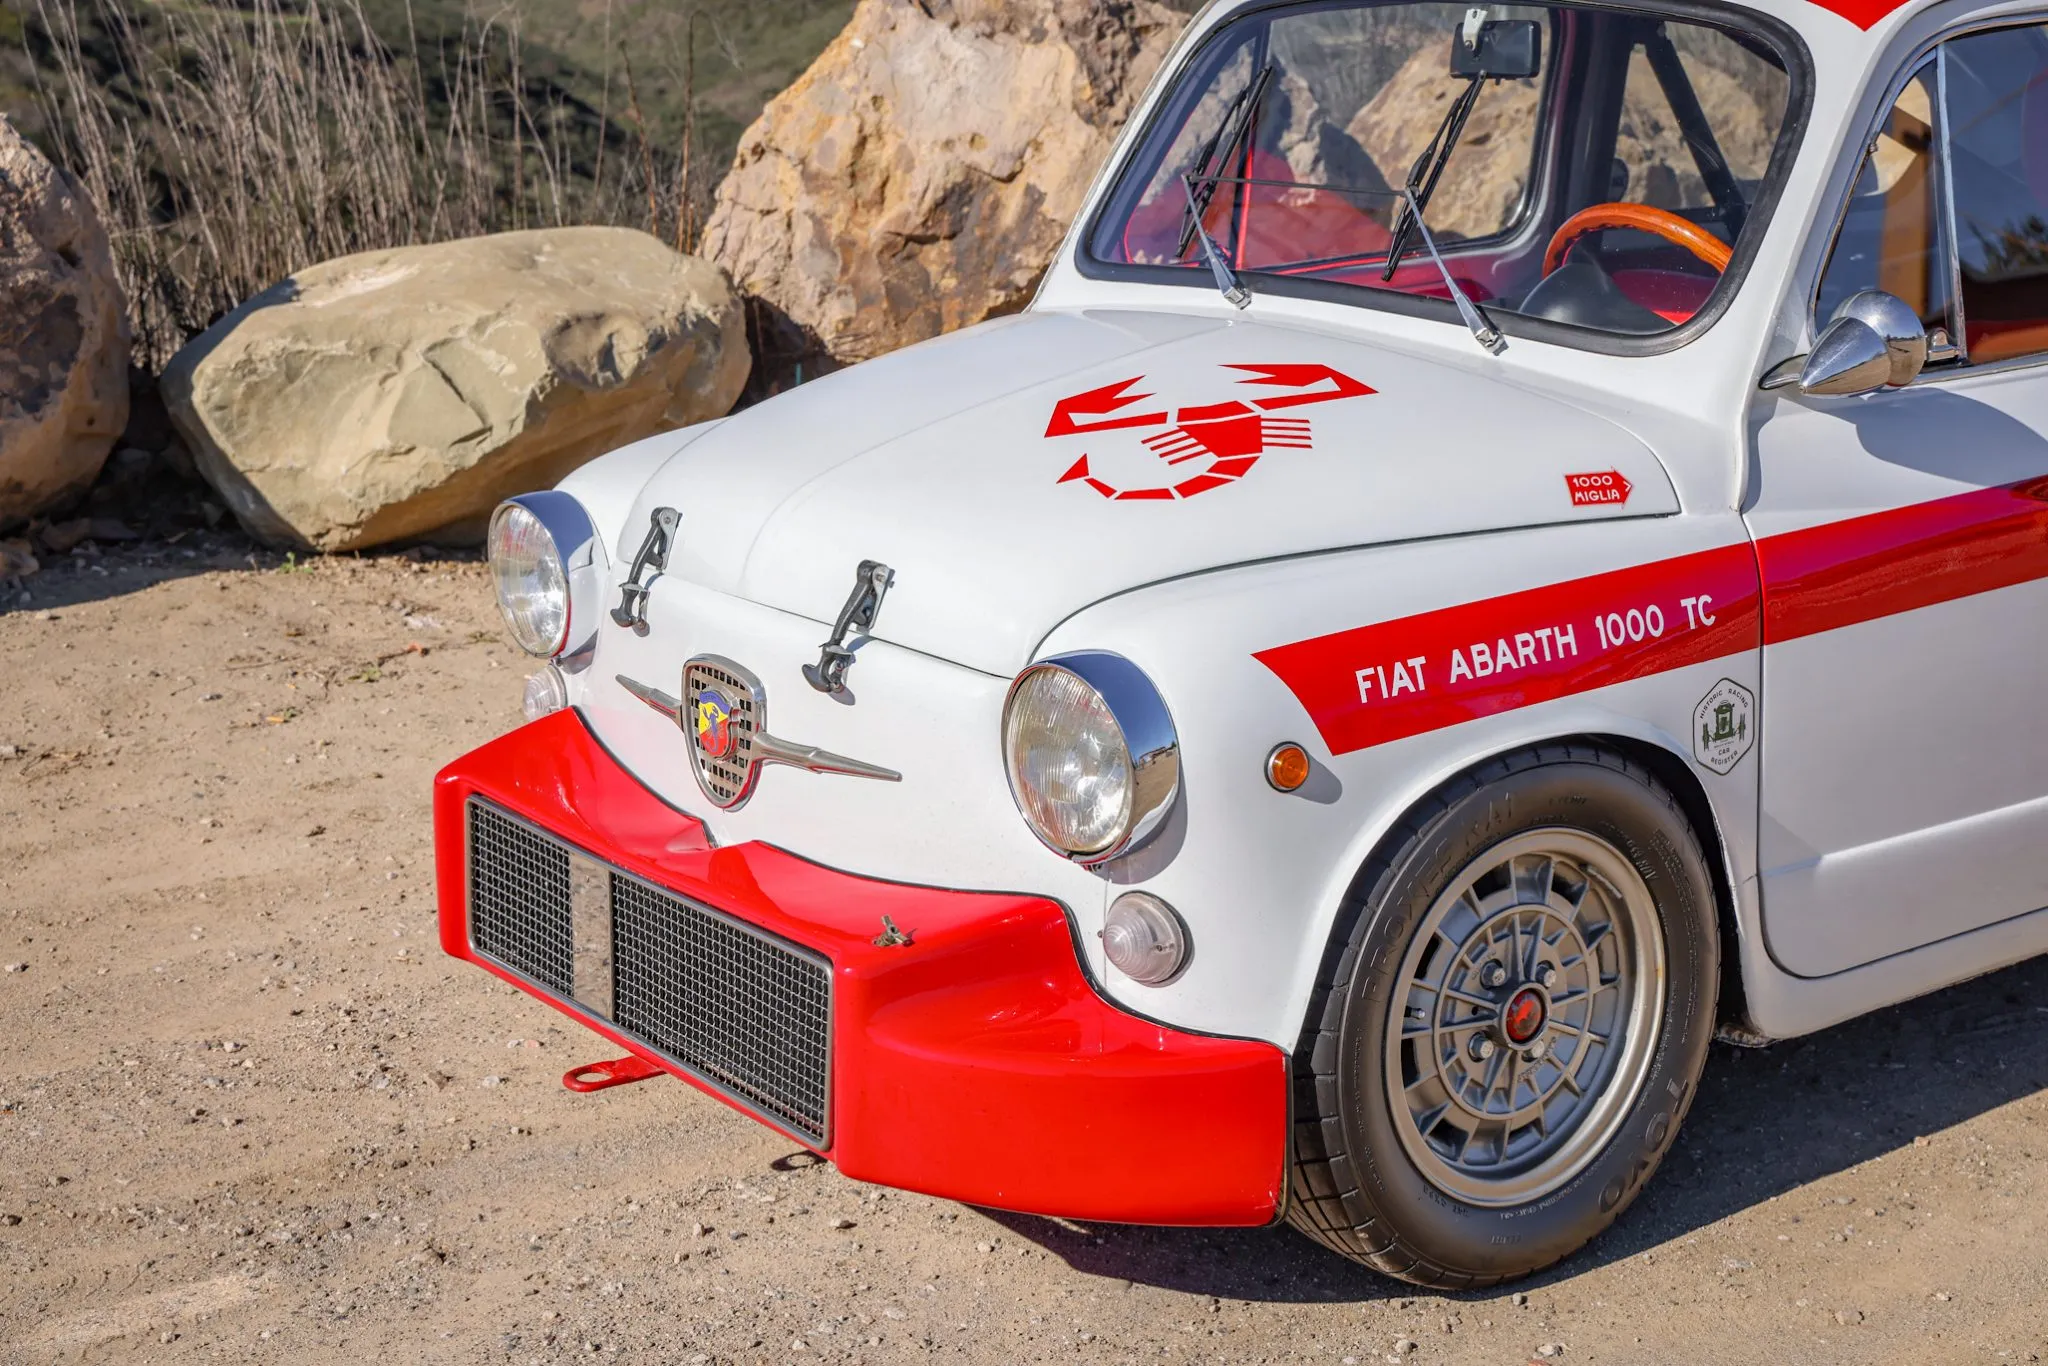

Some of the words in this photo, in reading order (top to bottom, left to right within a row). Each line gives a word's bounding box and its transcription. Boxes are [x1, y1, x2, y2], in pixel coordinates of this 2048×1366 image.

[1573, 475, 1612, 487] 1000
[1575, 489, 1620, 502] MIGLIA
[1355, 656, 1426, 703] FIAT
[1449, 623, 1578, 683] ABARTH
[1595, 604, 1664, 649] 1000
[1680, 594, 1716, 630] TC
[1700, 690, 1723, 719] HISTORIC
[1728, 689, 1748, 708] RACING
[1711, 751, 1738, 765] REGISTER
[1718, 747, 1730, 755] CAR
[1599, 1078, 1688, 1214] TOYO
